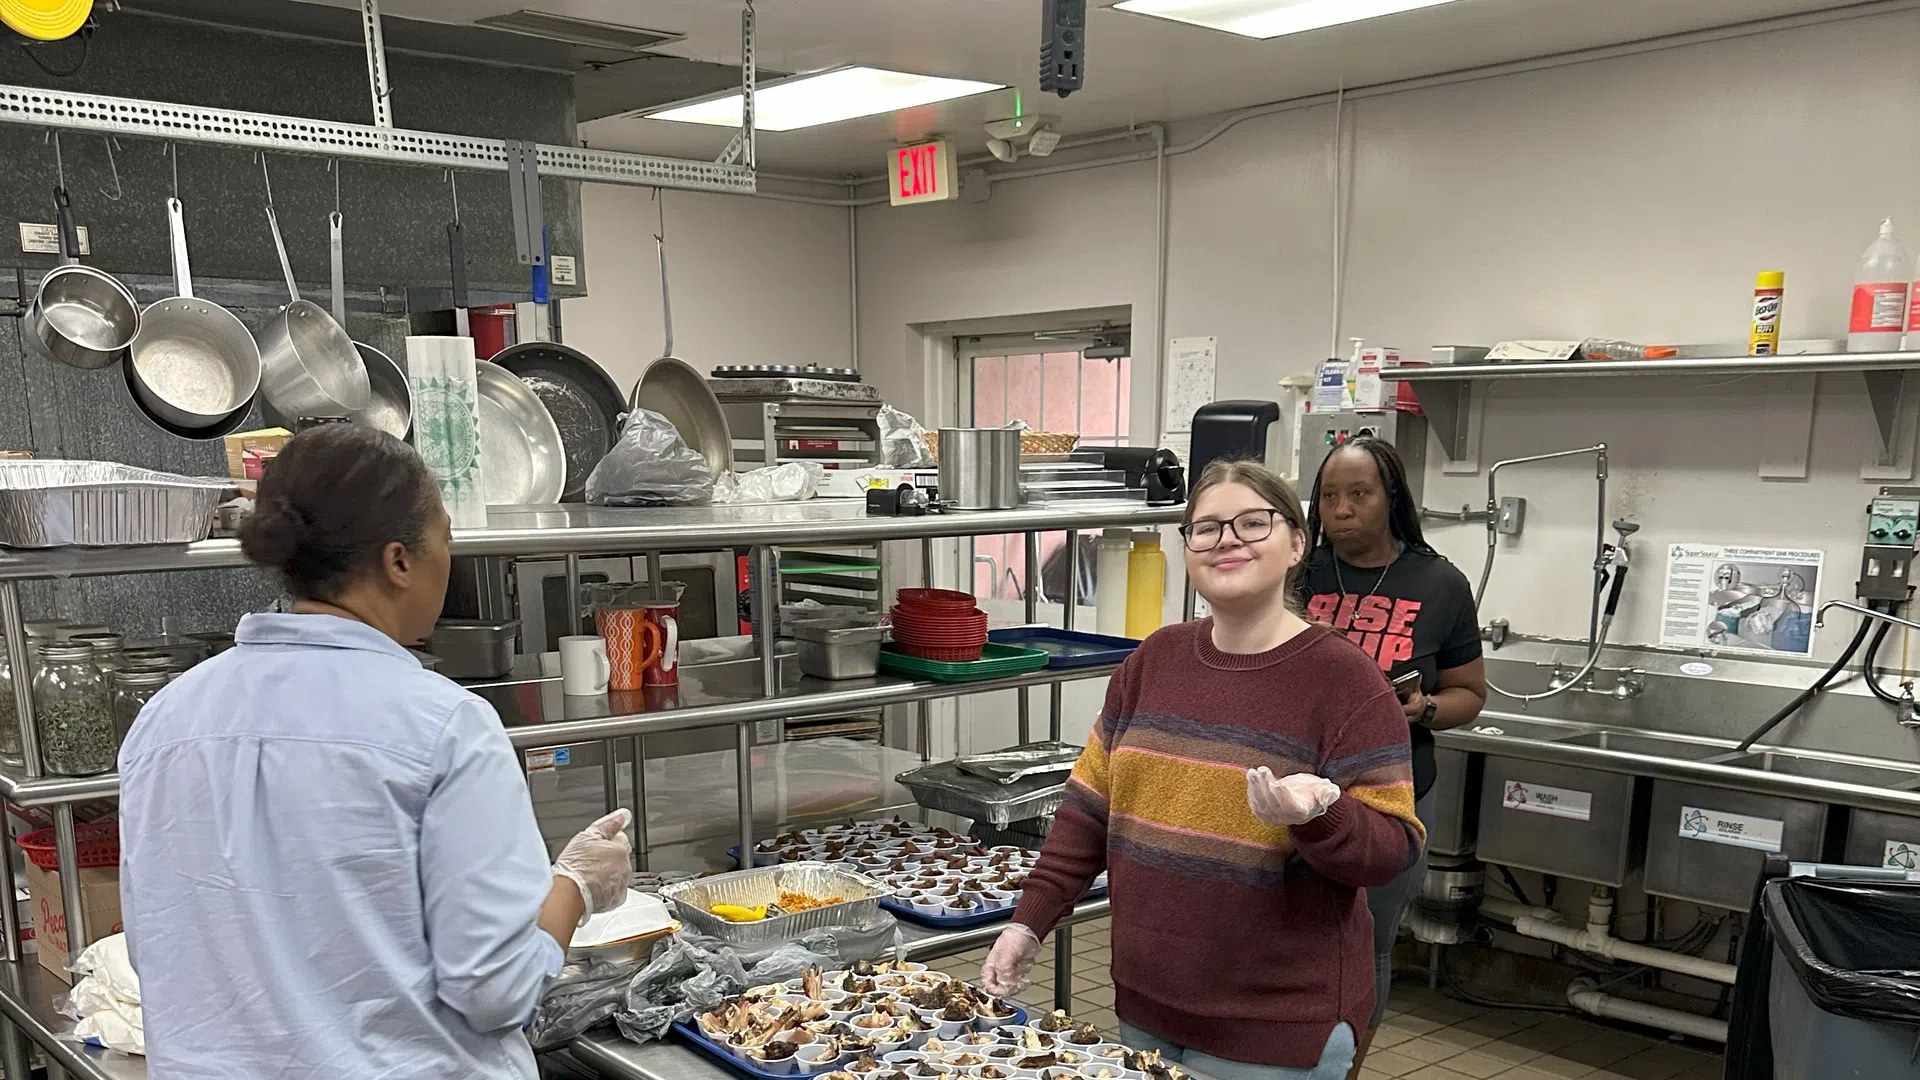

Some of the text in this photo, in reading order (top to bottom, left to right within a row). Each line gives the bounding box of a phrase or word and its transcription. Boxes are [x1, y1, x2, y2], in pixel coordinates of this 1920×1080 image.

[898, 145, 937, 197] EXIT
[1305, 593, 1421, 636] RISE
[1535, 793, 1558, 802] WASH
[1717, 820, 1744, 831] RINSE
